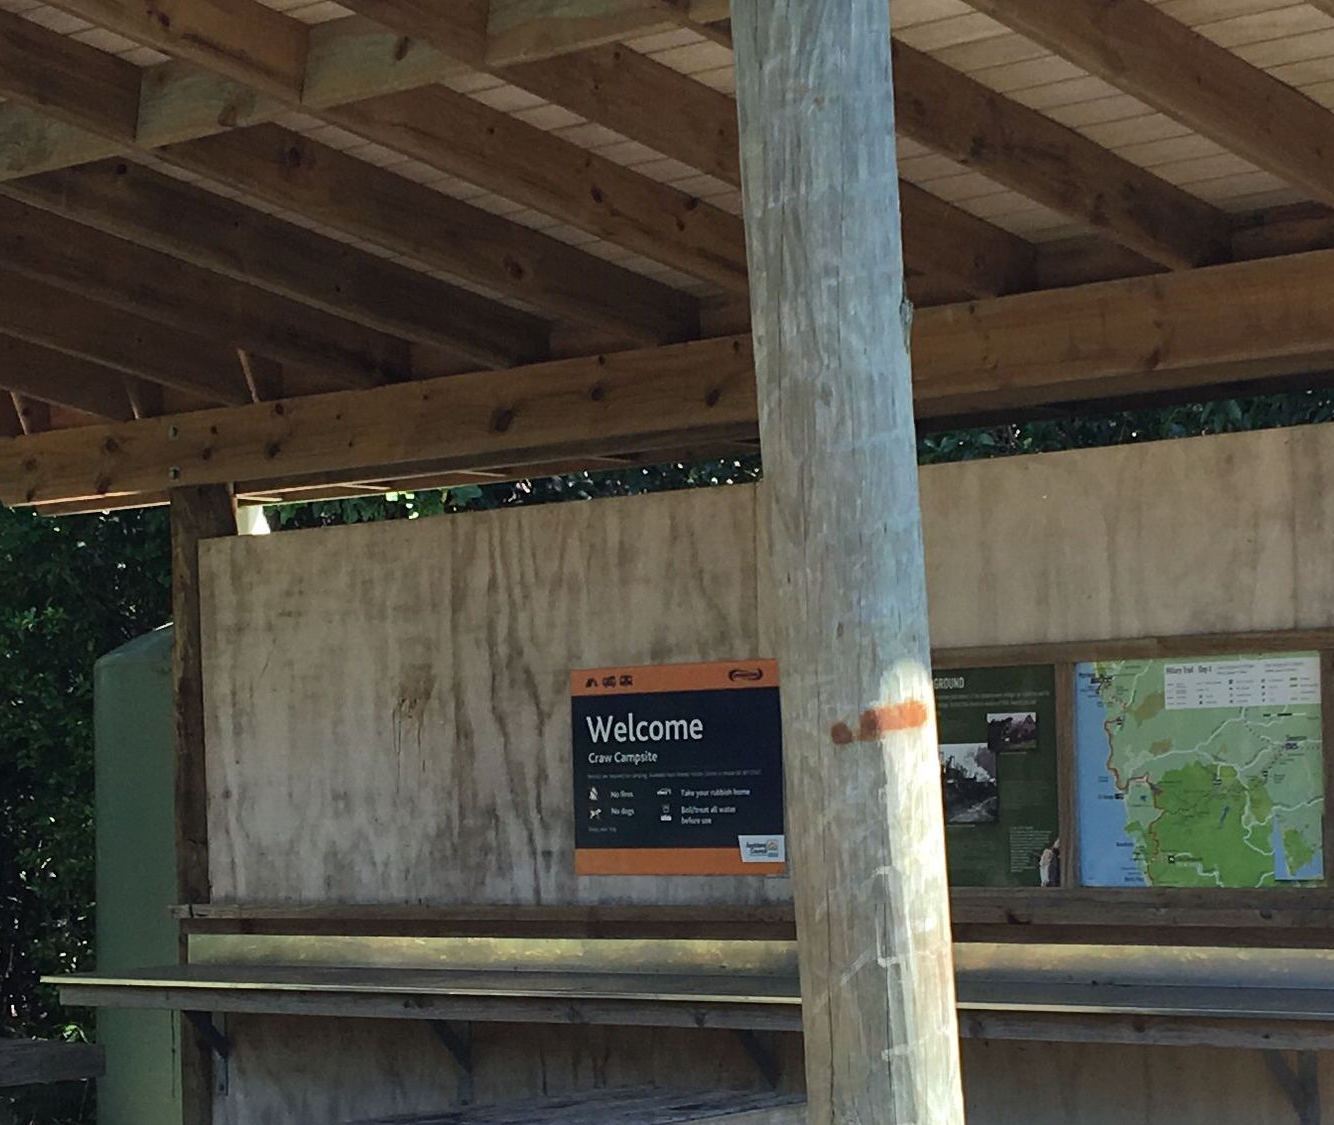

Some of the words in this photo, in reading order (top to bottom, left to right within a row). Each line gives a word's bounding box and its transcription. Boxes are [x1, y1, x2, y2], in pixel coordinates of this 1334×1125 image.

[586, 713, 704, 743] Welcome
[588, 753, 612, 764] Craw
[614, 750, 658, 766] Campsite
[681, 788, 694, 797] Take
[695, 788, 710, 799] your
[711, 788, 733, 797] rubbish
[733, 787, 750, 796] home
[621, 807, 635, 816] dogs
[681, 816, 701, 825] before
